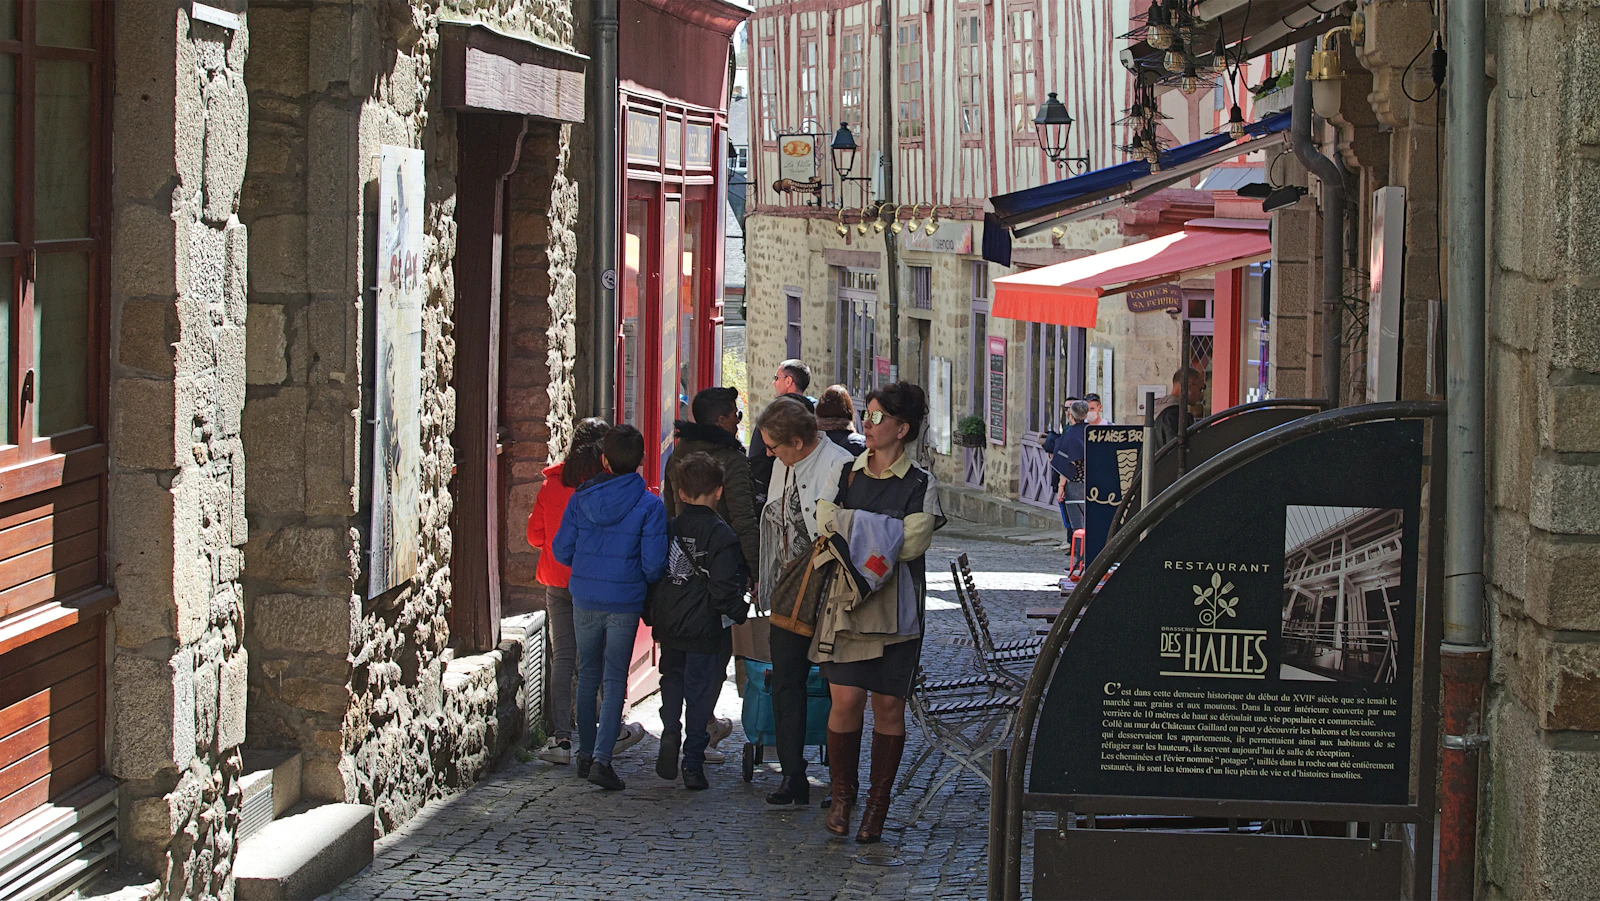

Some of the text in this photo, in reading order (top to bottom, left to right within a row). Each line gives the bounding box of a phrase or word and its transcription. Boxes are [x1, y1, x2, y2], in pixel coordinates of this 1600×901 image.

[1132, 297, 1180, 309] SA FEMME
[1164, 560, 1271, 573] RESTAURANT
[1160, 632, 1269, 674] DES HALLES
[1133, 688, 1151, 696] dans
[1173, 690, 1205, 699] demeure
[1207, 691, 1244, 701] historique
[1245, 692, 1256, 700] du
[1257, 692, 1278, 701] début
[1280, 693, 1290, 702] du
[1317, 695, 1339, 704] siècle
[1340, 697, 1354, 705] que
[1367, 697, 1387, 705] tenait
[1390, 697, 1397, 705] le
[1103, 698, 1130, 707] marché
[1150, 699, 1173, 710] grains
[1204, 703, 1238, 711] moutons.
[1241, 703, 1261, 711] Dans
[1263, 703, 1271, 712] la
[1294, 704, 1329, 714] intérieure
[1367, 709, 1380, 717] par
[1102, 709, 1131, 718] verrière
[1132, 709, 1142, 718] de
[1144, 710, 1154, 718] 10
[1154, 710, 1180, 719] mètres
[1181, 711, 1191, 720] de
[1192, 711, 1208, 720] haut
[1219, 713, 1252, 722] déroulait
[1269, 714, 1281, 723] vie
[1282, 716, 1317, 725] populaire
[1326, 717, 1376, 726] commerciale.
[1102, 719, 1123, 728] Collé
[1150, 721, 1160, 729] du
[1161, 721, 1196, 731] Châteaux
[1197, 723, 1228, 732] Gaillard
[1239, 726, 1256, 734] peut
[1256, 727, 1262, 735] y
[1263, 725, 1299, 734] découvrir
[1299, 726, 1311, 735] les
[1311, 727, 1340, 736] balcons
[1349, 728, 1360, 736] les
[1360, 729, 1396, 738] coursives
[1101, 730, 1114, 740] qui
[1117, 730, 1163, 740] desservaient
[1167, 732, 1178, 741] les
[1181, 735, 1232, 743] appartements,
[1236, 735, 1245, 743] ils
[1249, 736, 1295, 745] permettaient
[1298, 737, 1316, 746] ainsi
[1337, 738, 1370, 747] habitants
[1373, 739, 1383, 748] de
[1101, 741, 1131, 751] réfugier
[1145, 742, 1156, 751] les
[1157, 743, 1191, 753] hauteurs,
[1192, 744, 1202, 753] ils
[1275, 747, 1285, 755] de
[1286, 748, 1304, 756] salle
[1305, 748, 1315, 756] de
[1101, 751, 1115, 760] Les
[1115, 752, 1154, 761] cheminées
[1186, 755, 1214, 764] nommé
[1256, 757, 1278, 766] taillés
[1279, 758, 1297, 766] dans
[1297, 758, 1305, 767] la
[1305, 759, 1326, 768] roche
[1339, 760, 1351, 768] été
[1351, 760, 1394, 770] entièrement
[1100, 763, 1135, 772] restaurés,
[1136, 763, 1145, 772] ils
[1163, 764, 1174, 773] les
[1175, 765, 1205, 774] témoins
[1224, 766, 1238, 775] lieu
[1239, 767, 1258, 777] plein
[1259, 768, 1269, 776] de
[1270, 768, 1282, 777] vie
[1330, 770, 1363, 779] insolites.
